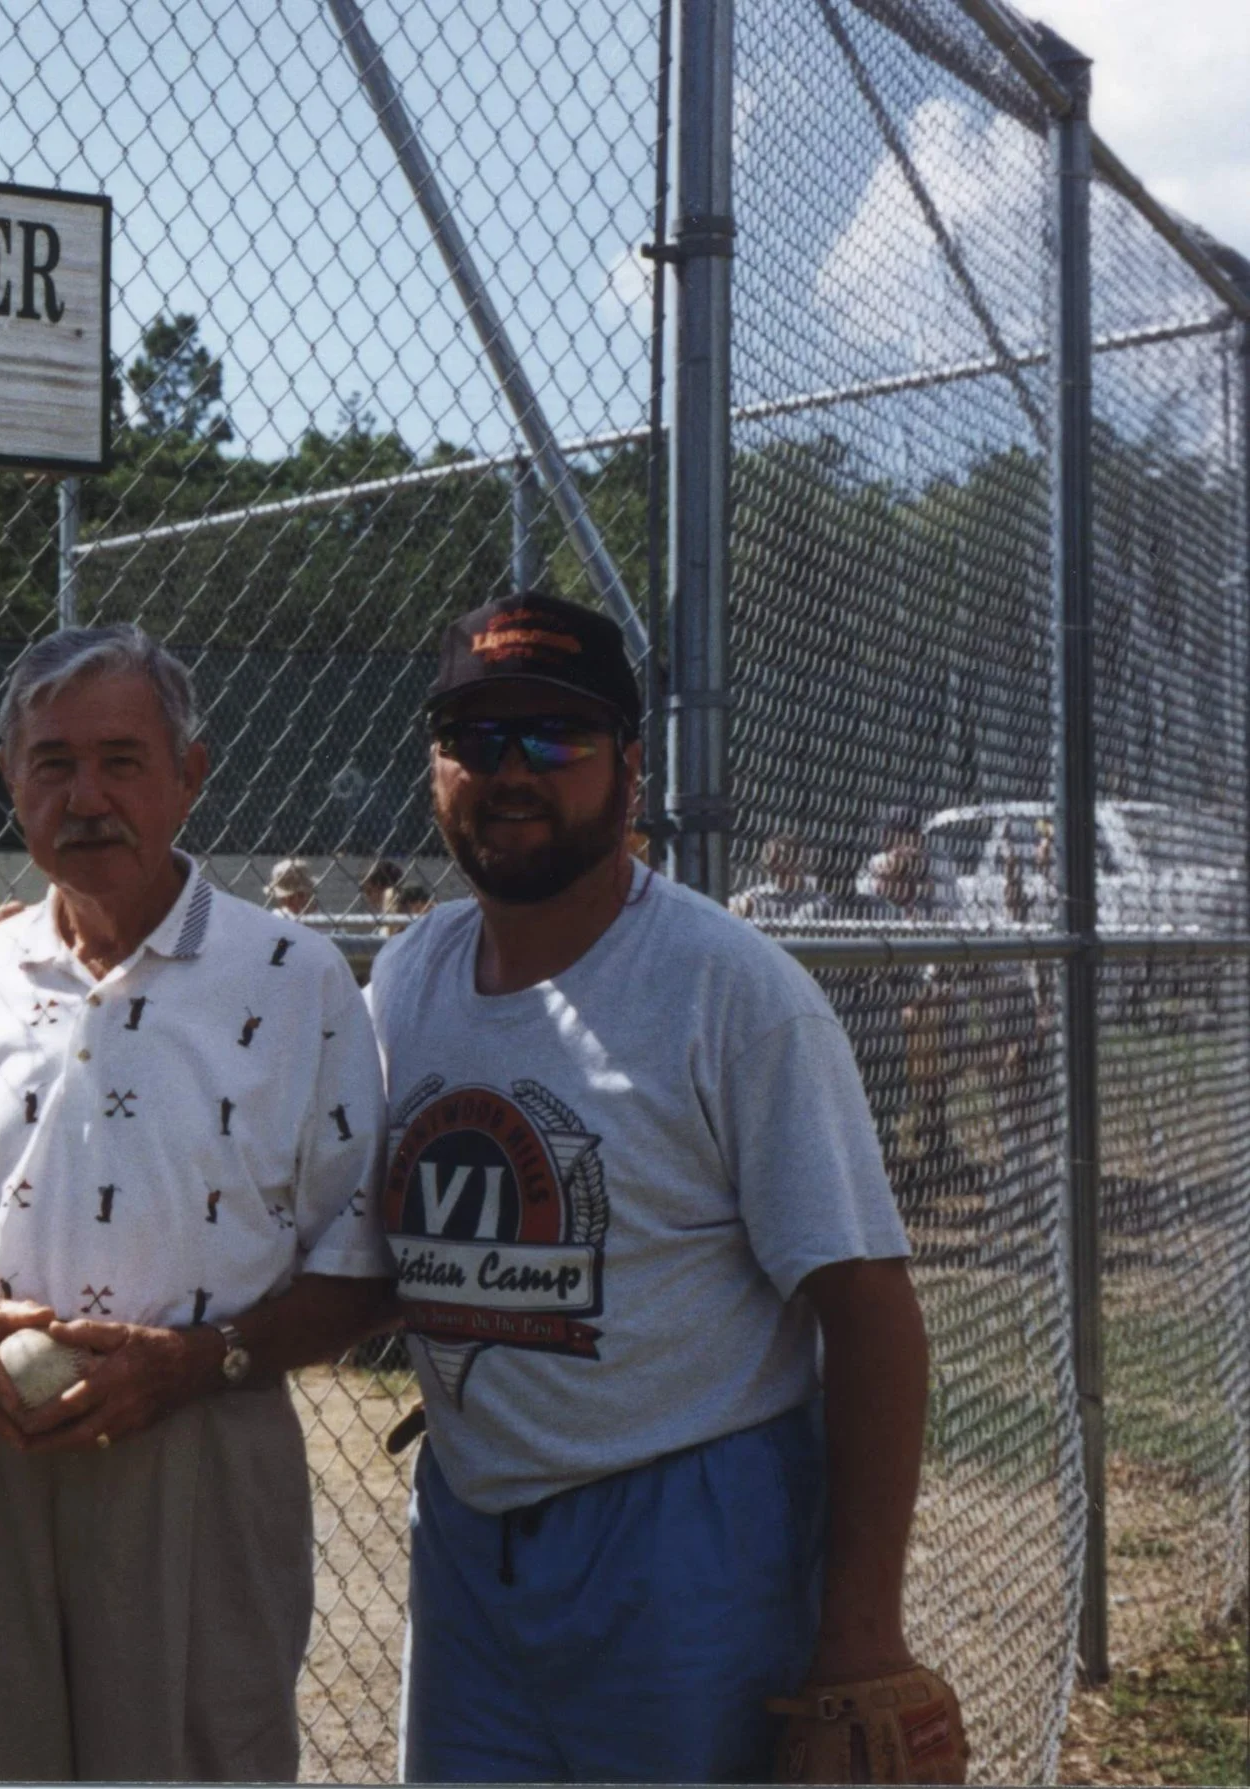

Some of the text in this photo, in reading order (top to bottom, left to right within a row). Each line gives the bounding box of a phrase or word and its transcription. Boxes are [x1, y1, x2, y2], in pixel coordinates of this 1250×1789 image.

[418, 1161, 506, 1240] VI
[400, 1248, 582, 1300] istian Camp
